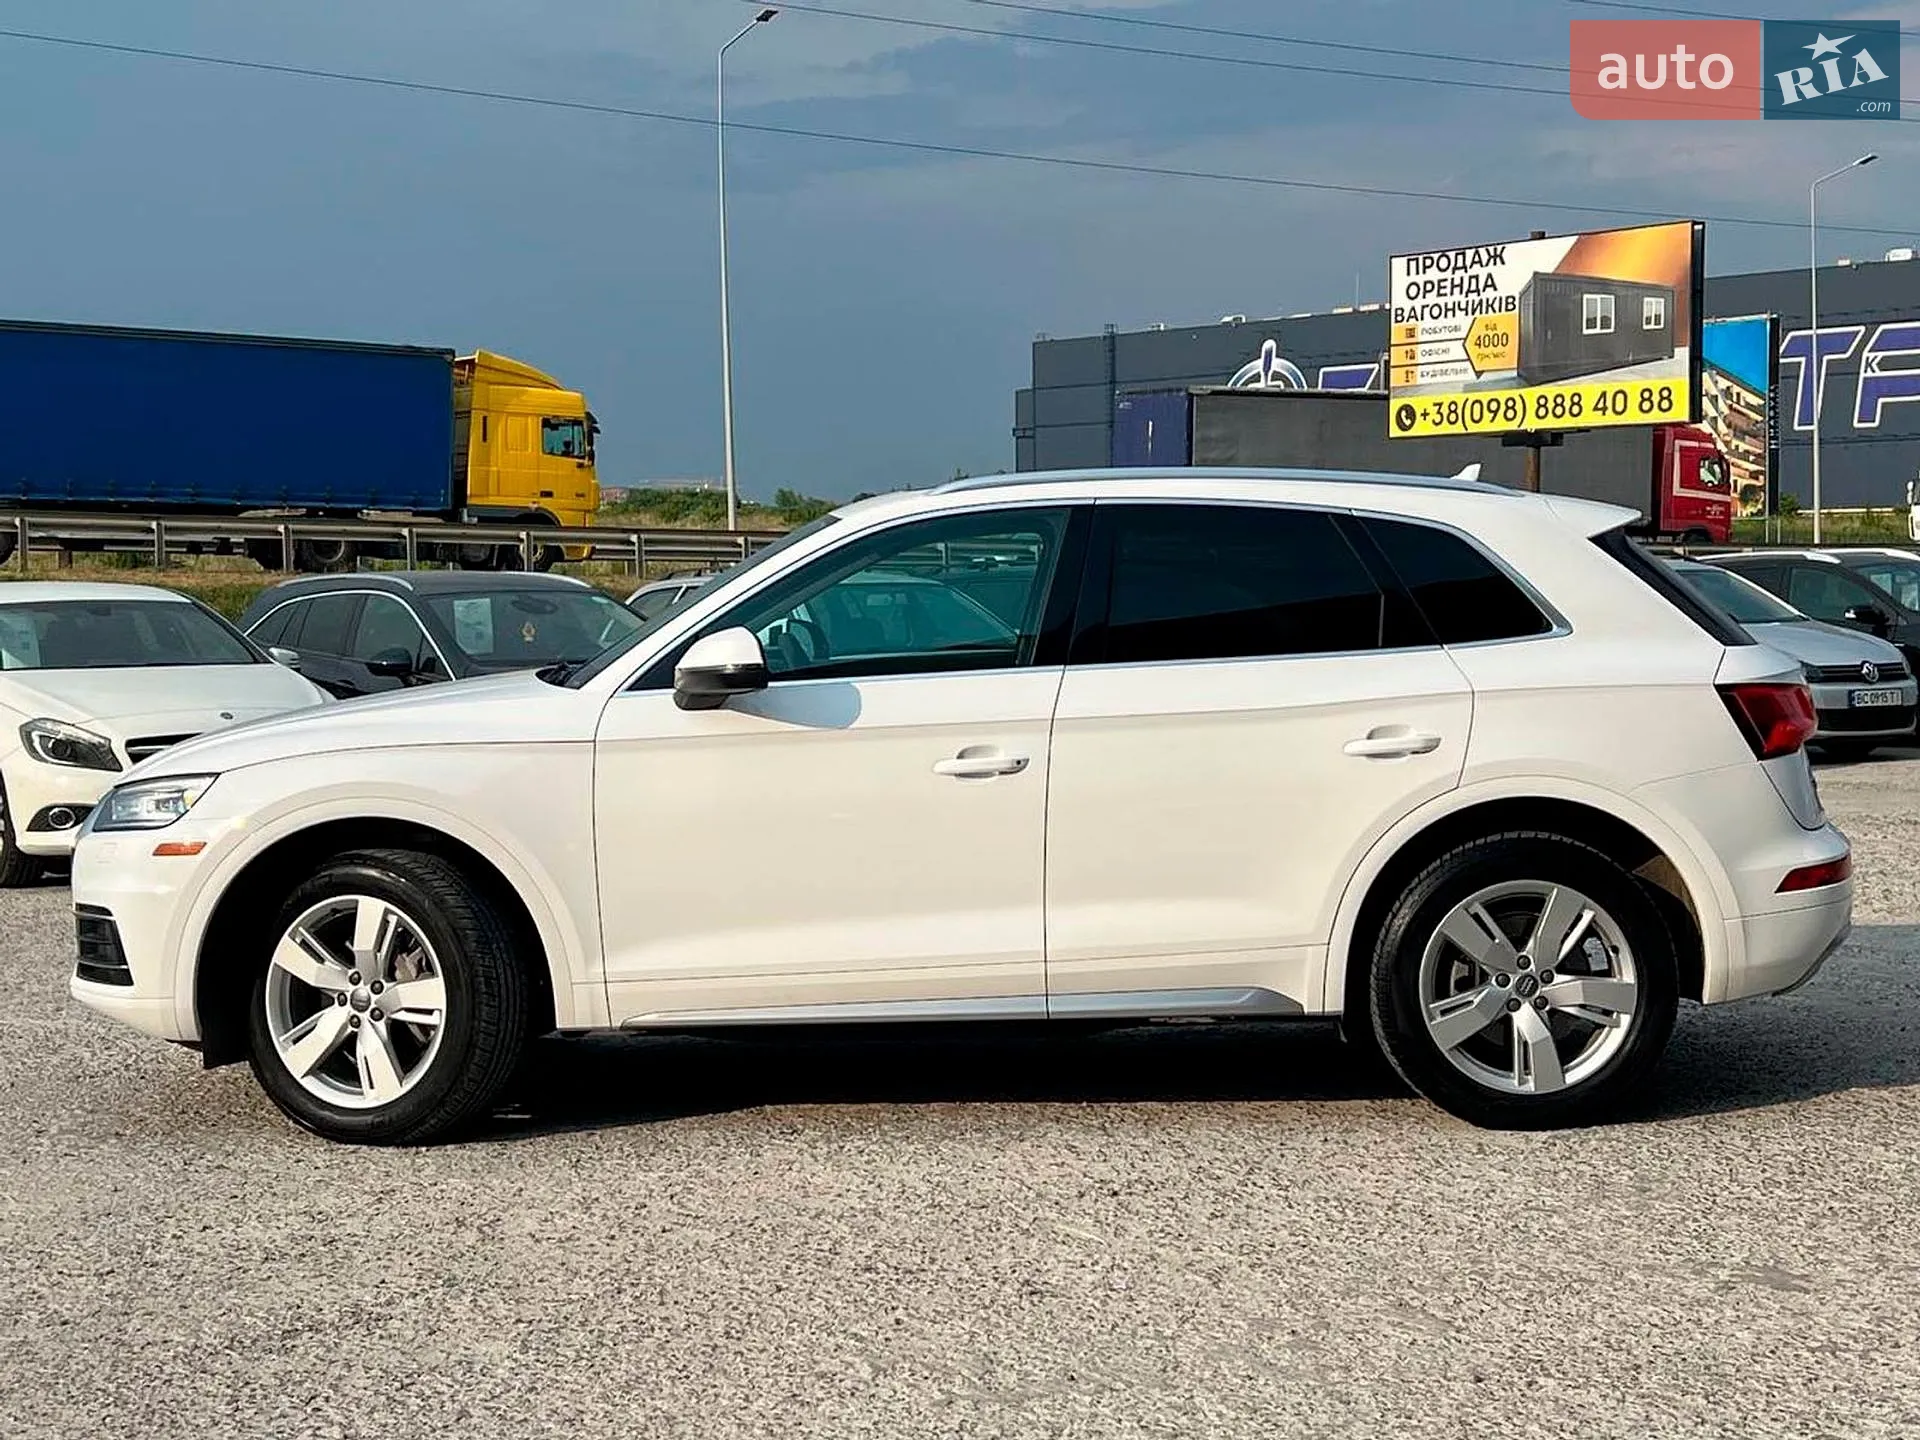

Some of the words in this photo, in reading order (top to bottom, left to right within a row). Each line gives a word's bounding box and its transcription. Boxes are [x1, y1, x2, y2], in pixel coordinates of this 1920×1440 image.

[1406, 246, 1506, 277] ПРОДАЖ
[1405, 272, 1498, 301] ОРЕНДА
[1394, 295, 1517, 324] ВАГОНЧИКІВ
[1474, 331, 1509, 349] 4000
[1420, 393, 1527, 432] +38(098)
[1535, 393, 1583, 420] 888
[1592, 389, 1628, 416] 40
[1638, 386, 1674, 414] 88
